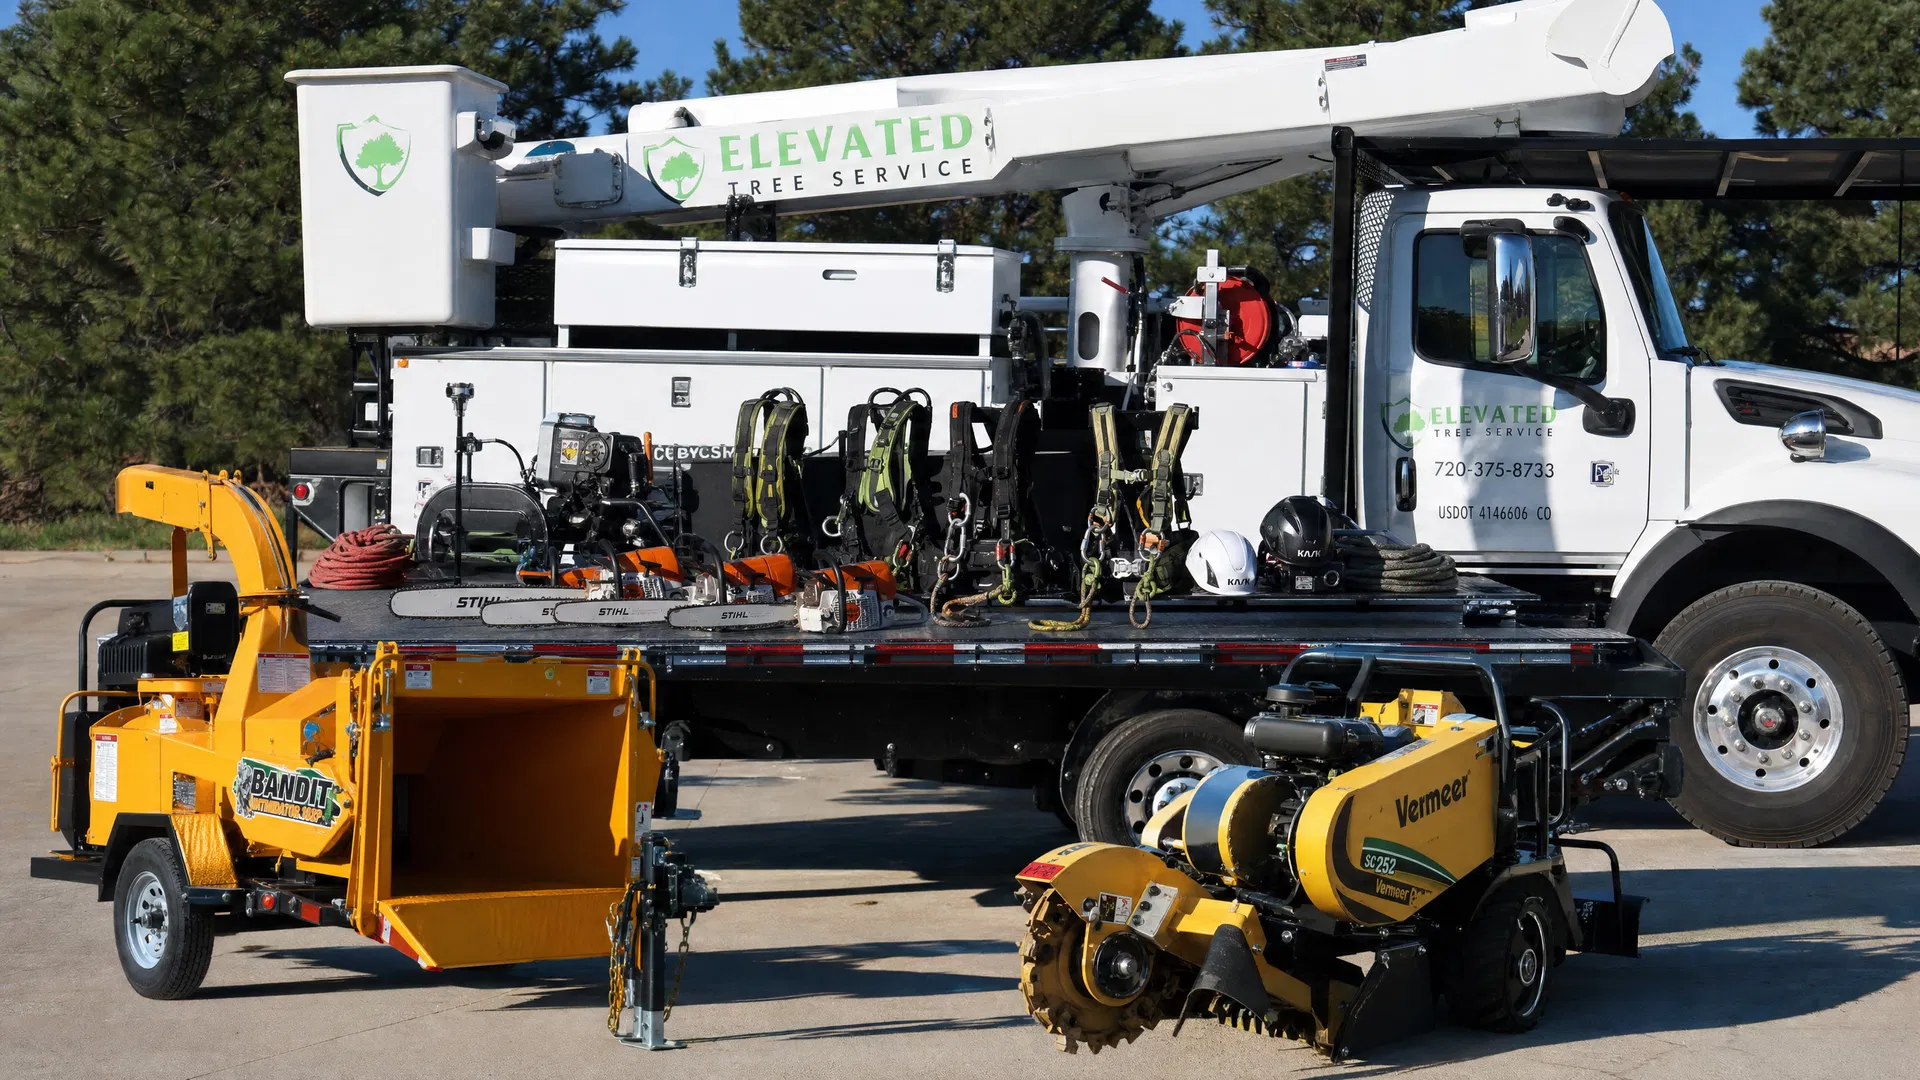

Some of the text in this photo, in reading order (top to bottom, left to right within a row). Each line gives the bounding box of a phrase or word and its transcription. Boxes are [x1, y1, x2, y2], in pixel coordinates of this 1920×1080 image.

[719, 113, 973, 172] ELEVATED
[728, 157, 973, 196] TREE SERVICE
[1431, 404, 1557, 425] ELEVATED
[1434, 427, 1553, 438] TREE SERVICE
[1434, 461, 1555, 478] 720-375-8733
[1438, 505, 1552, 520] USDOT 4146606 CO
[1296, 549, 1321, 558] KASK
[1227, 578, 1251, 586] KASK
[598, 607, 629, 616] STIHL
[721, 611, 748, 620] STIHL
[250, 767, 333, 809] BANDIT
[1395, 774, 1468, 829] Vermeer
[1364, 853, 1397, 875] SC252
[1375, 878, 1410, 901] Vermeer
